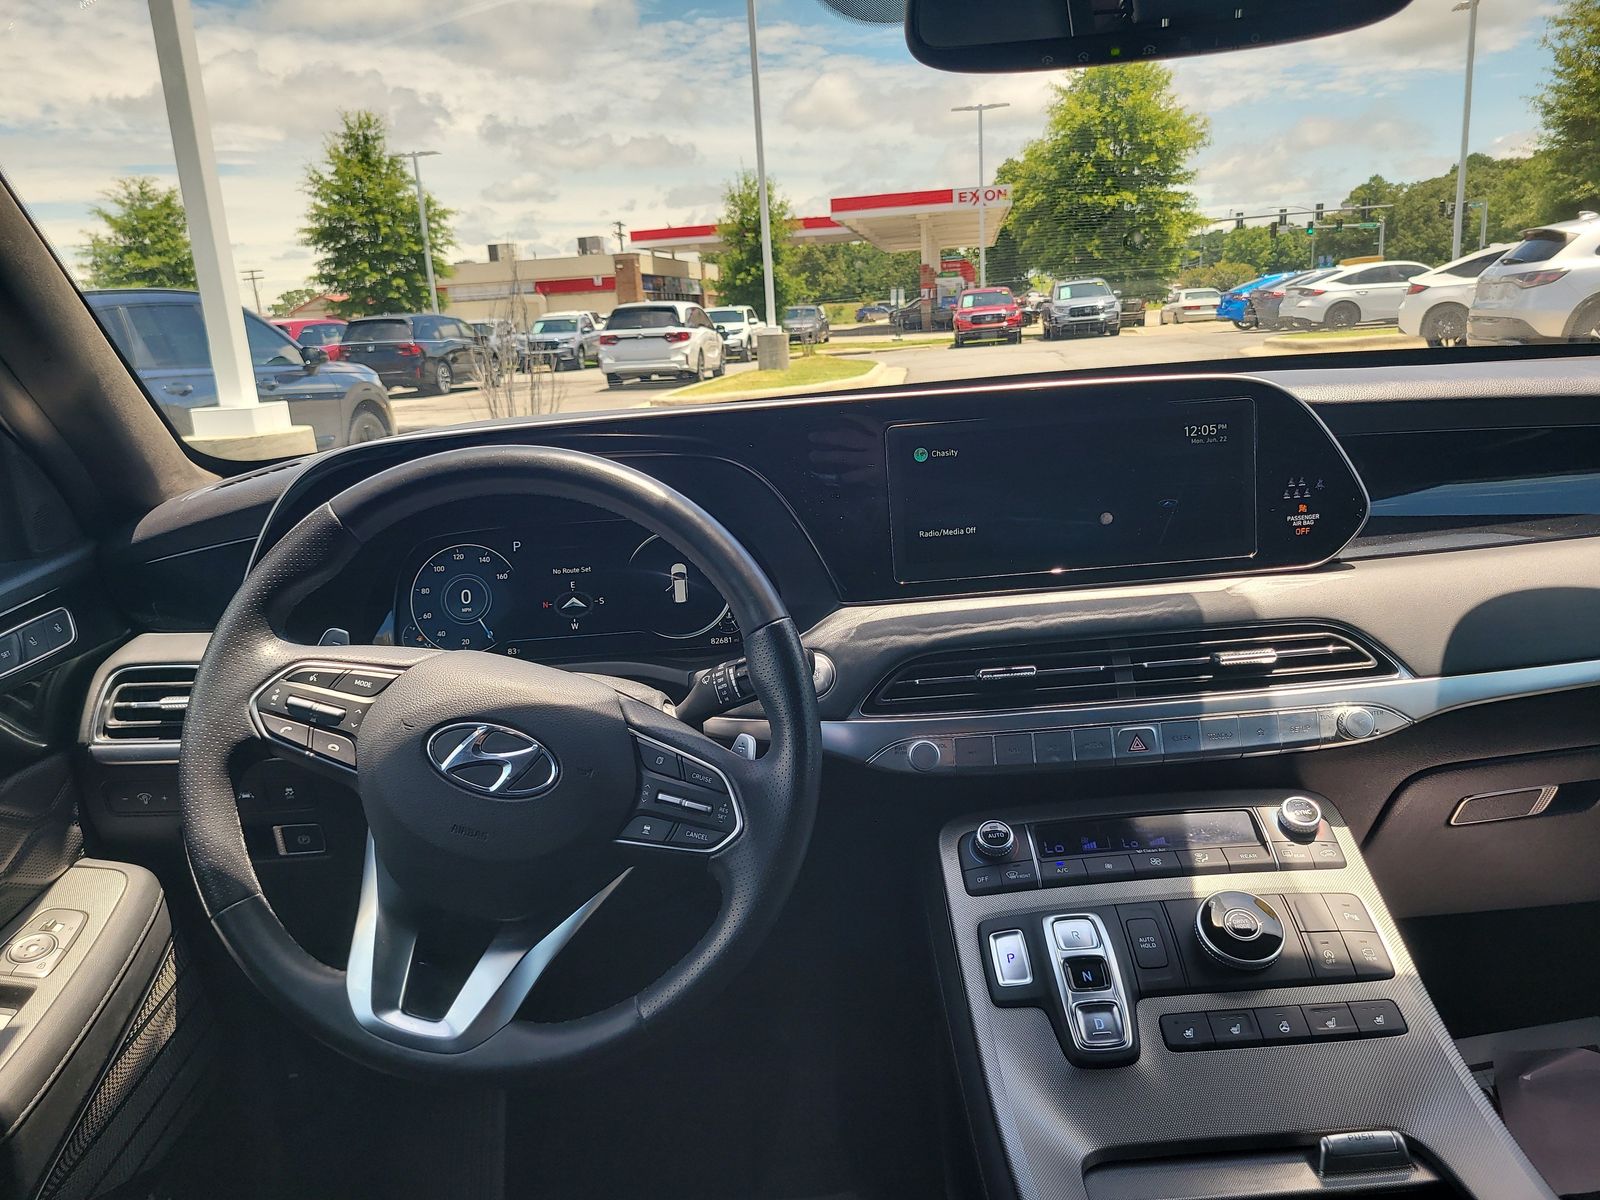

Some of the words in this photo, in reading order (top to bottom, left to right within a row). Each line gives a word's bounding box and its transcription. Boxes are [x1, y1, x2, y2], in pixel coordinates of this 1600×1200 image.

[958, 189, 1007, 206] EXON
[1184, 424, 1217, 437] 12:05
[931, 448, 959, 459] Chasity
[1287, 514, 1320, 522] PASSENGER
[919, 527, 964, 539] Radio/Media
[965, 526, 976, 536] Off
[1295, 527, 1311, 536] OFF
[513, 541, 521, 552] P
[570, 581, 576, 589] E
[460, 589, 472, 604] 0
[599, 597, 605, 605] S
[570, 622, 579, 630] W
[710, 636, 733, 645] 82681
[354, 679, 373, 688] MODE
[691, 772, 713, 784] CRUISE
[685, 830, 709, 841] CANCEL
[1071, 930, 1081, 941] R
[1006, 952, 1015, 964] P
[1082, 970, 1093, 983] N
[1094, 1017, 1105, 1030] D
[1347, 1132, 1375, 1141] PUSH
